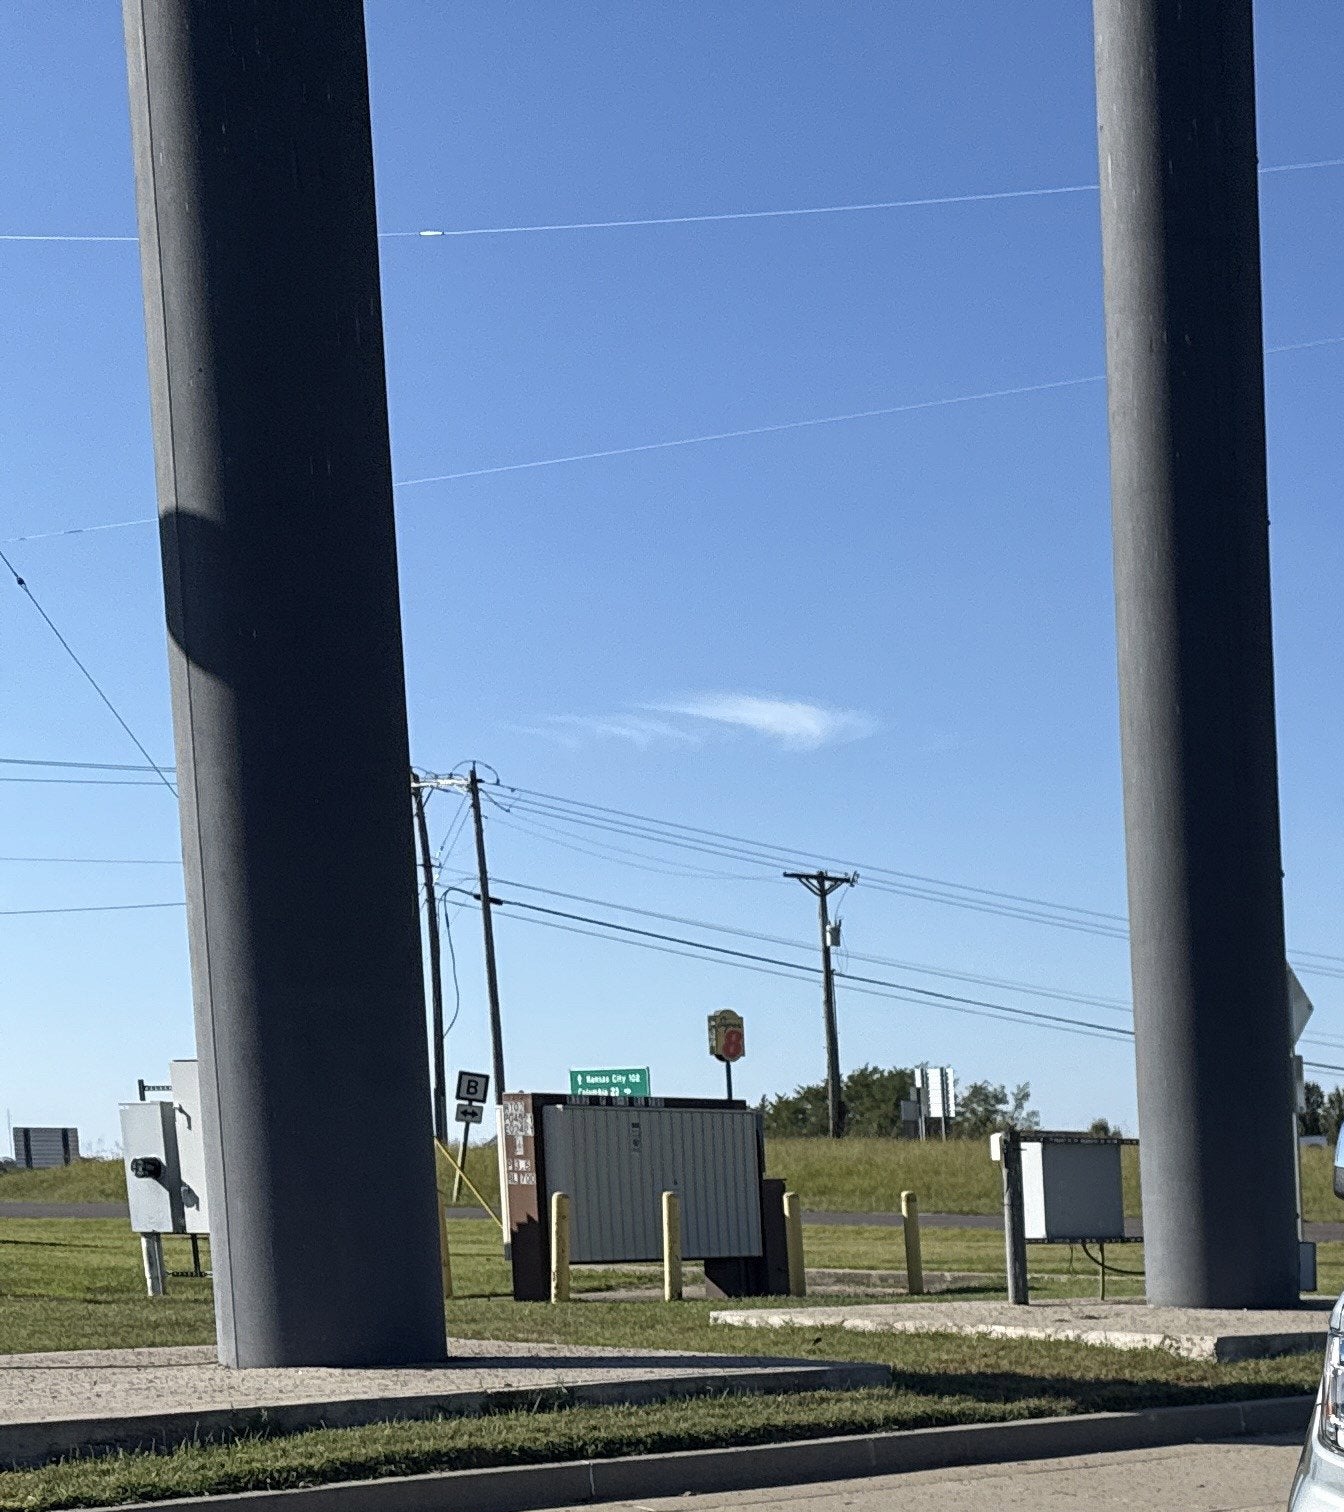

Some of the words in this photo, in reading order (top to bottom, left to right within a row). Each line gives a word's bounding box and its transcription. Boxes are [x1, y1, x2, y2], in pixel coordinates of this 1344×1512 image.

[585, 1075, 610, 1084] Kansas
[612, 1074, 626, 1085] City
[466, 1080, 479, 1095] B
